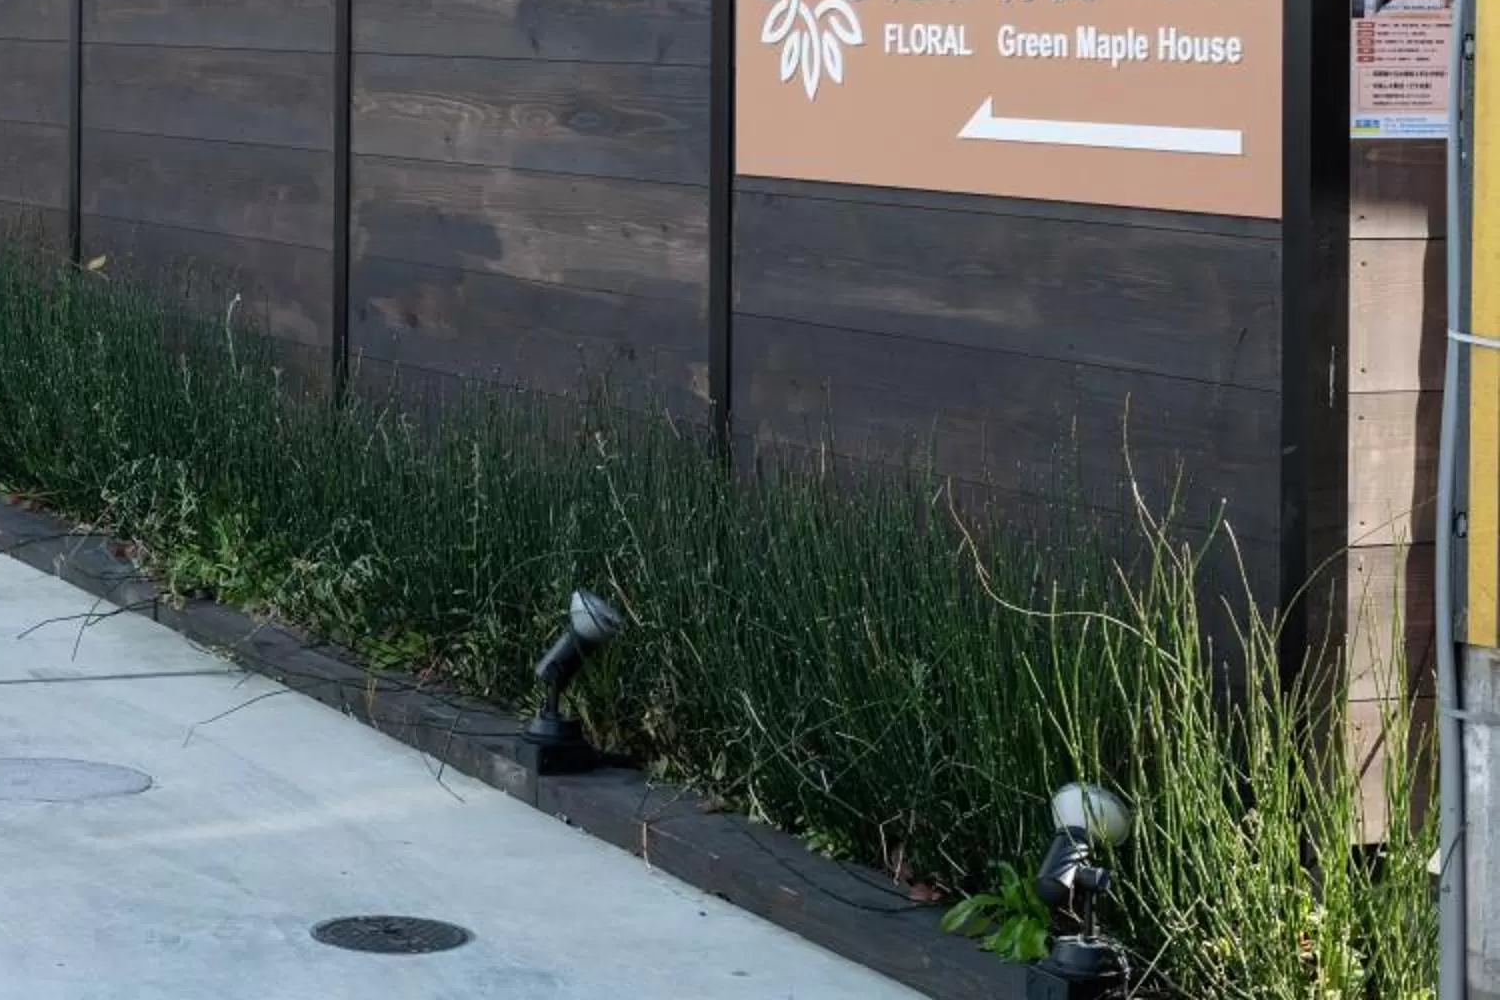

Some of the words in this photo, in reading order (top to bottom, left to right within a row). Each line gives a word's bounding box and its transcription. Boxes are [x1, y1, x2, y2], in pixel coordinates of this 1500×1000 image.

[884, 22, 973, 57] FLORAL
[997, 23, 1069, 58] Green
[1075, 24, 1150, 68] Maple
[1157, 26, 1244, 64] House
